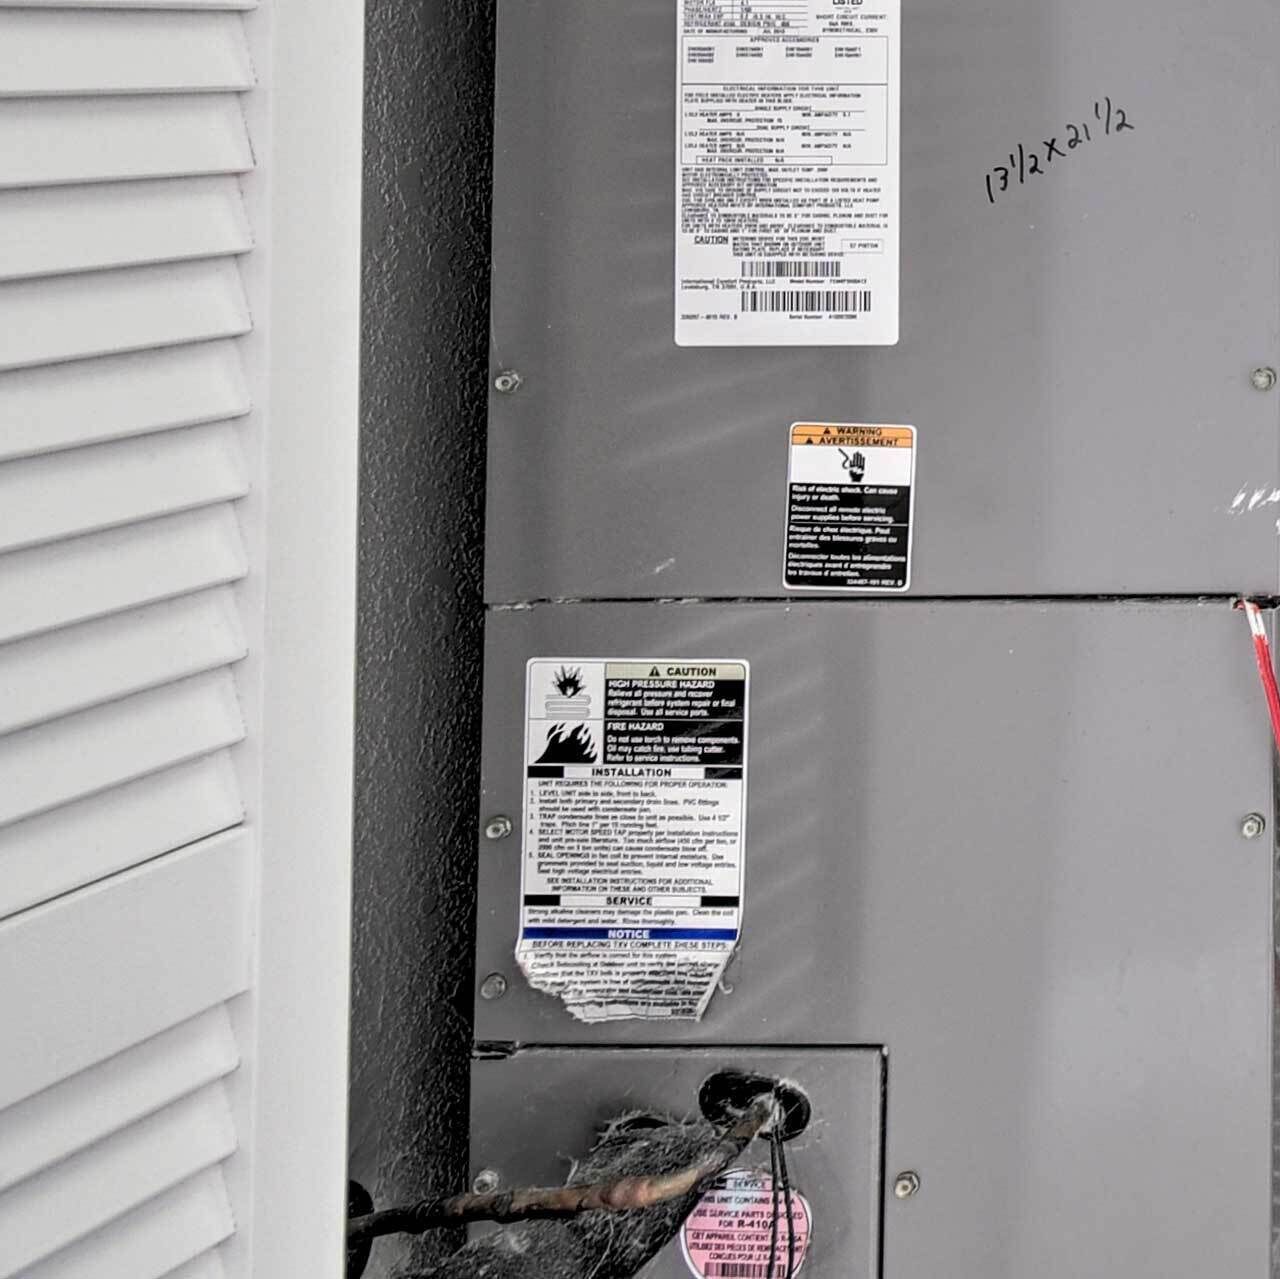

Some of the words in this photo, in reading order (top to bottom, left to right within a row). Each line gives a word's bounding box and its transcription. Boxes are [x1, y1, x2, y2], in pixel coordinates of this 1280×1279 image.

[694, 236, 729, 244] CAUTION
[837, 427, 882, 436] WARNING
[819, 437, 898, 446] AVERTISSEMENT
[667, 667, 716, 676] CAUTION
[592, 768, 671, 777] INSTALLATION
[606, 896, 652, 905] SERVICE
[608, 930, 650, 939] NOTICE
[532, 941, 564, 949] BEFORE
